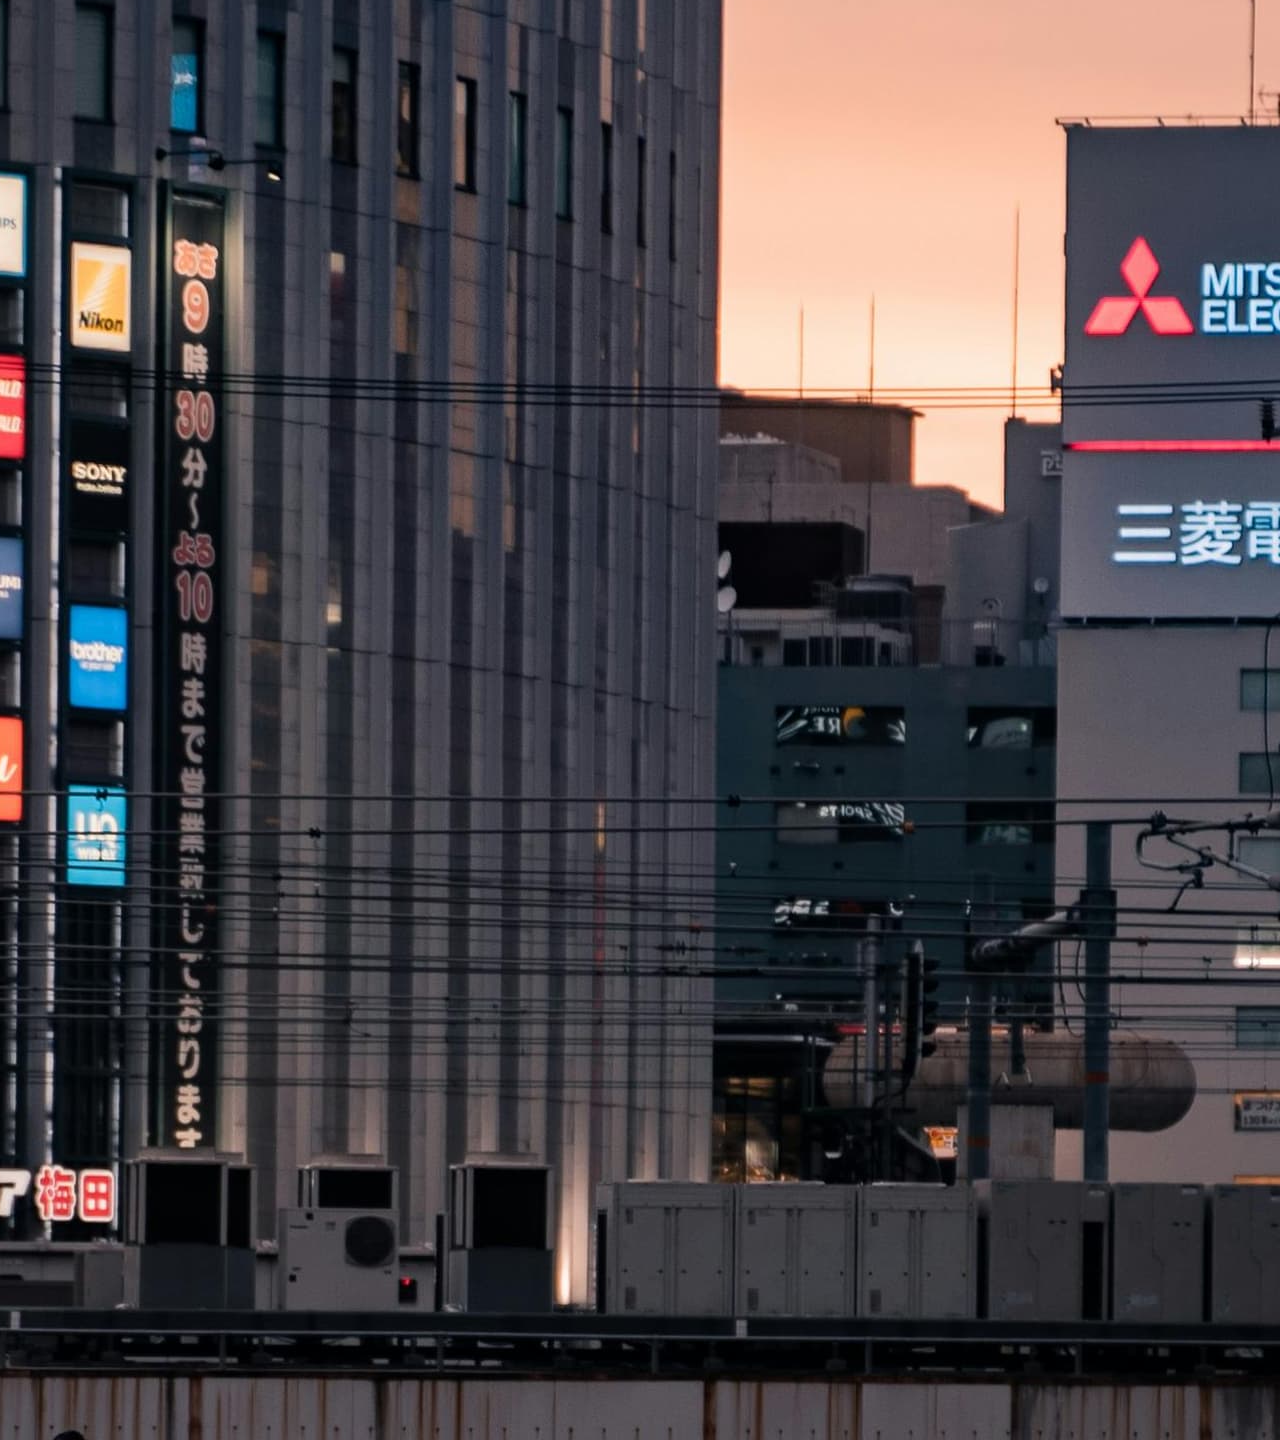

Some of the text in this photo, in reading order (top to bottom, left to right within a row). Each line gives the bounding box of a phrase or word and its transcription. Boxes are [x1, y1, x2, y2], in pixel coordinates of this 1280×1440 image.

[79, 311, 124, 332] Nikon
[71, 461, 127, 482] SONY
[70, 639, 124, 663] brother
[74, 810, 118, 848] UQ
